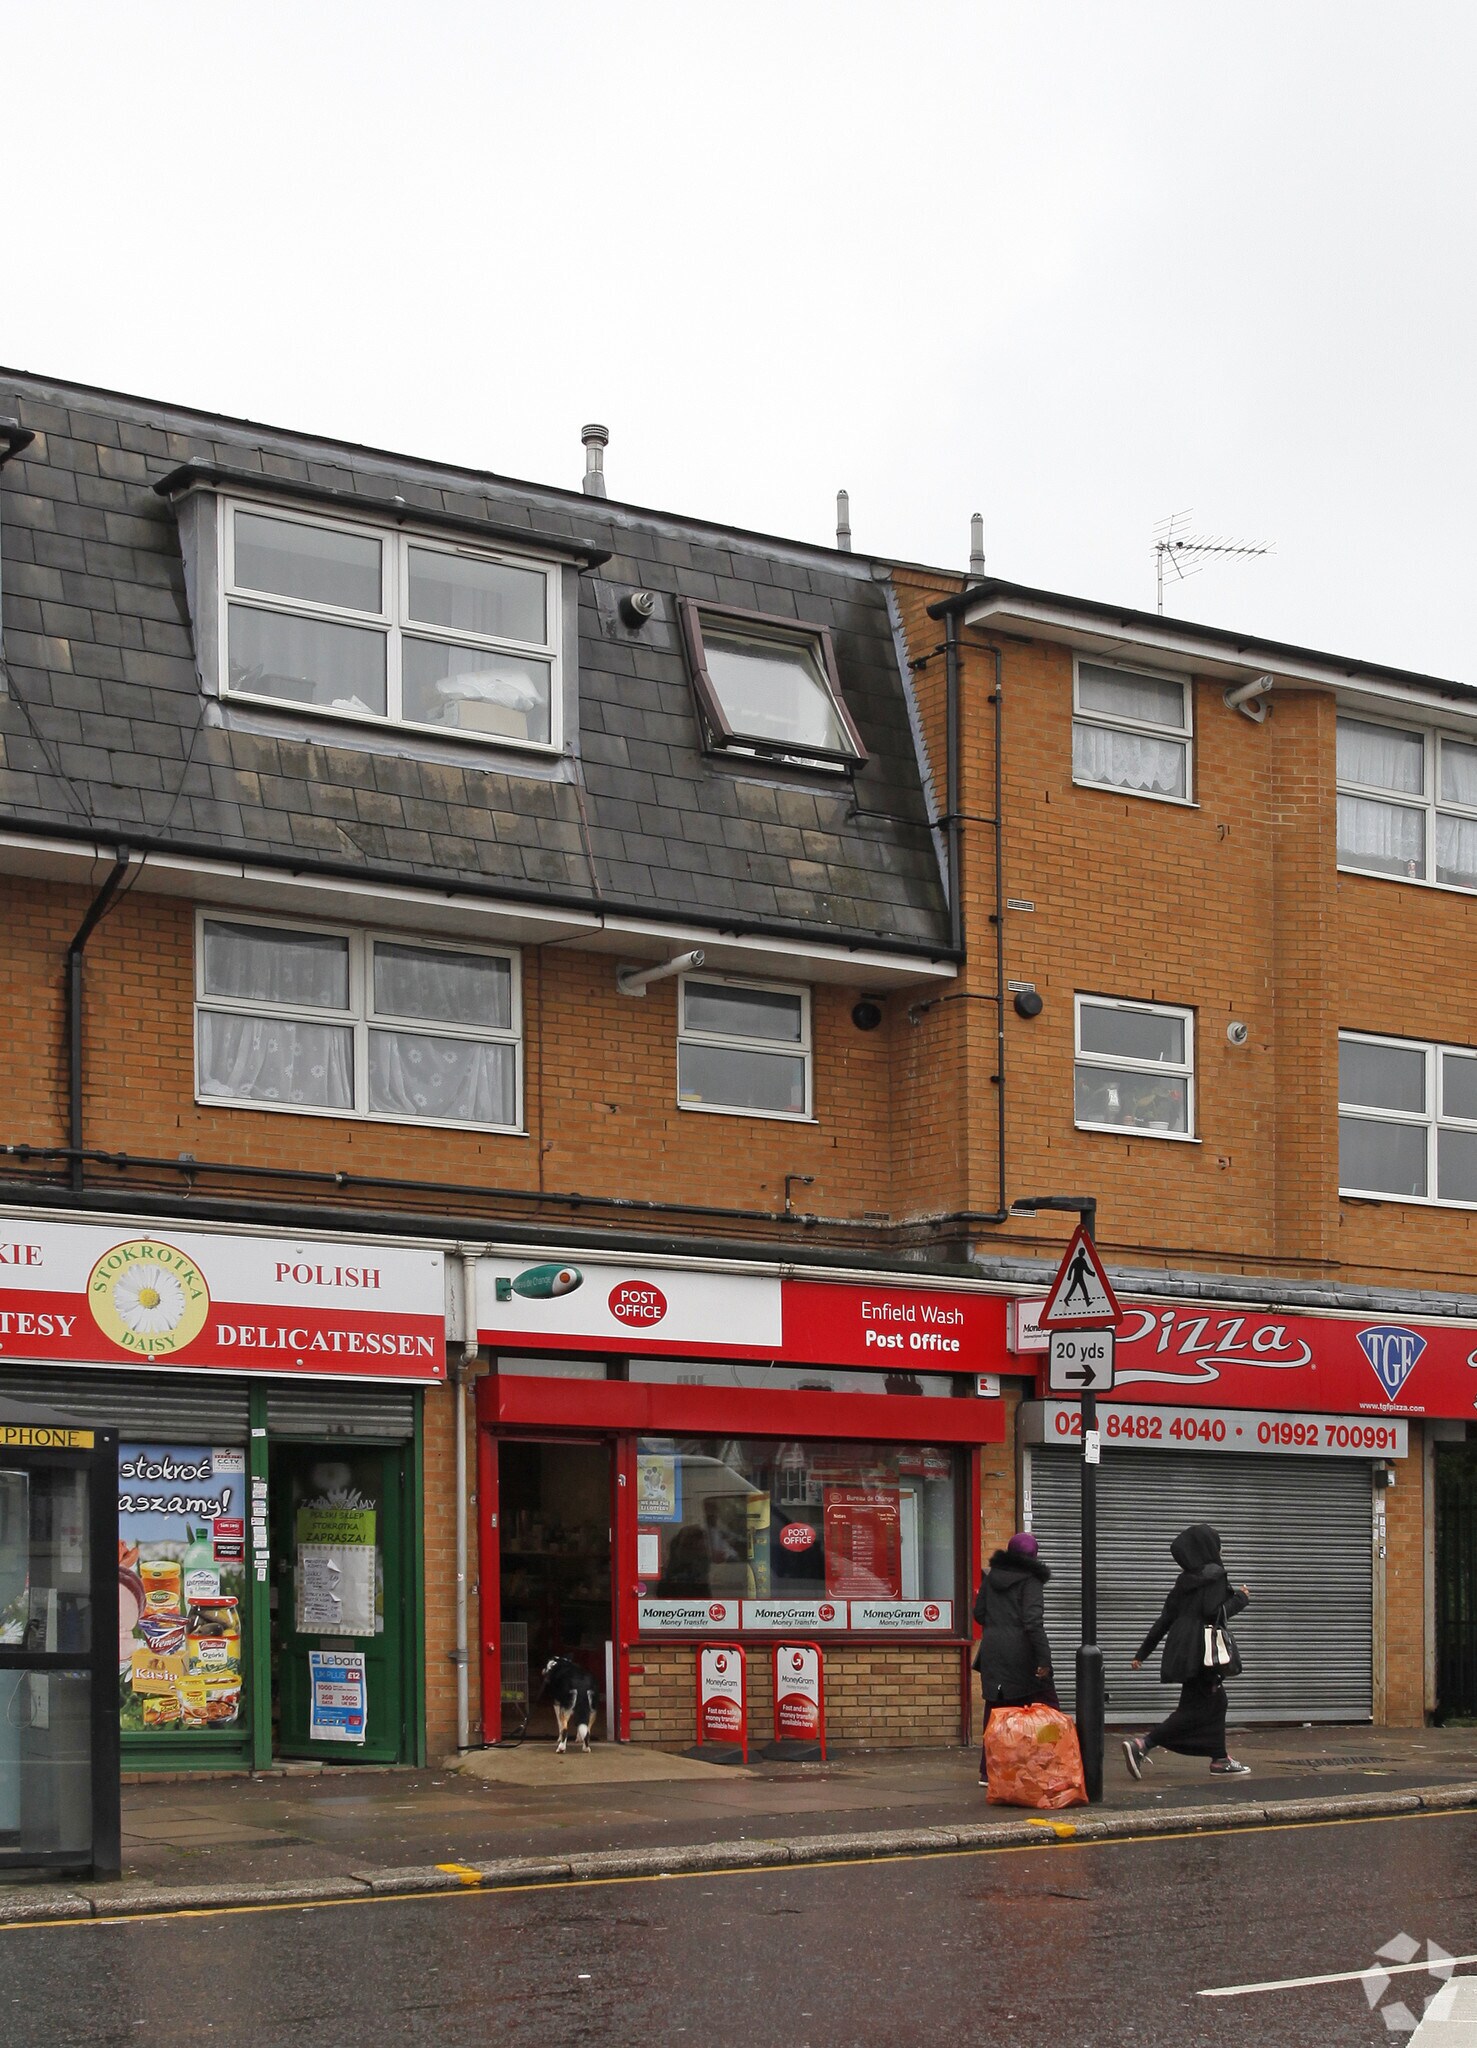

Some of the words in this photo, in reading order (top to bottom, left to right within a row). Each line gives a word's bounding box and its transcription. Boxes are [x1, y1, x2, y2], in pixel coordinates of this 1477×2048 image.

[93, 1246, 203, 1300] STOKROTKA
[275, 1262, 382, 1289] POLISH
[621, 1290, 656, 1304] POST
[614, 1304, 661, 1319] OFFICE
[861, 1301, 916, 1321] Enfield
[920, 1305, 964, 1325] Wash
[0, 1312, 77, 1337] TESY
[121, 1331, 177, 1352] DAISY
[216, 1324, 435, 1357] DELICATESSEN
[865, 1330, 904, 1348] Post
[909, 1332, 960, 1352] Office
[1056, 1343, 1075, 1358] 20
[1080, 1342, 1104, 1362] yds
[1366, 1333, 1415, 1387] TGF
[1359, 1402, 1426, 1412] www.tgfpizza.com
[0, 1427, 80, 1447] PHONE
[1055, 1411, 1099, 1436] 02
[1107, 1414, 1162, 1439] 8482
[1169, 1417, 1226, 1441] 4040
[1257, 1421, 1319, 1446] 01992
[1325, 1424, 1397, 1449] 700991
[121, 1456, 211, 1480] stokroć
[306, 1532, 366, 1543] ZAPRASZA!
[783, 1536, 812, 1544] OFFICE
[643, 1608, 705, 1618] MoneyGram
[755, 1608, 815, 1619] MoneyGram
[863, 1609, 920, 1619] MoneyGram
[879, 1619, 899, 1627] Money
[321, 1654, 363, 1667] Lebara
[705, 1678, 738, 1687] MoneyGram
[781, 1675, 815, 1684] MoneyGram
